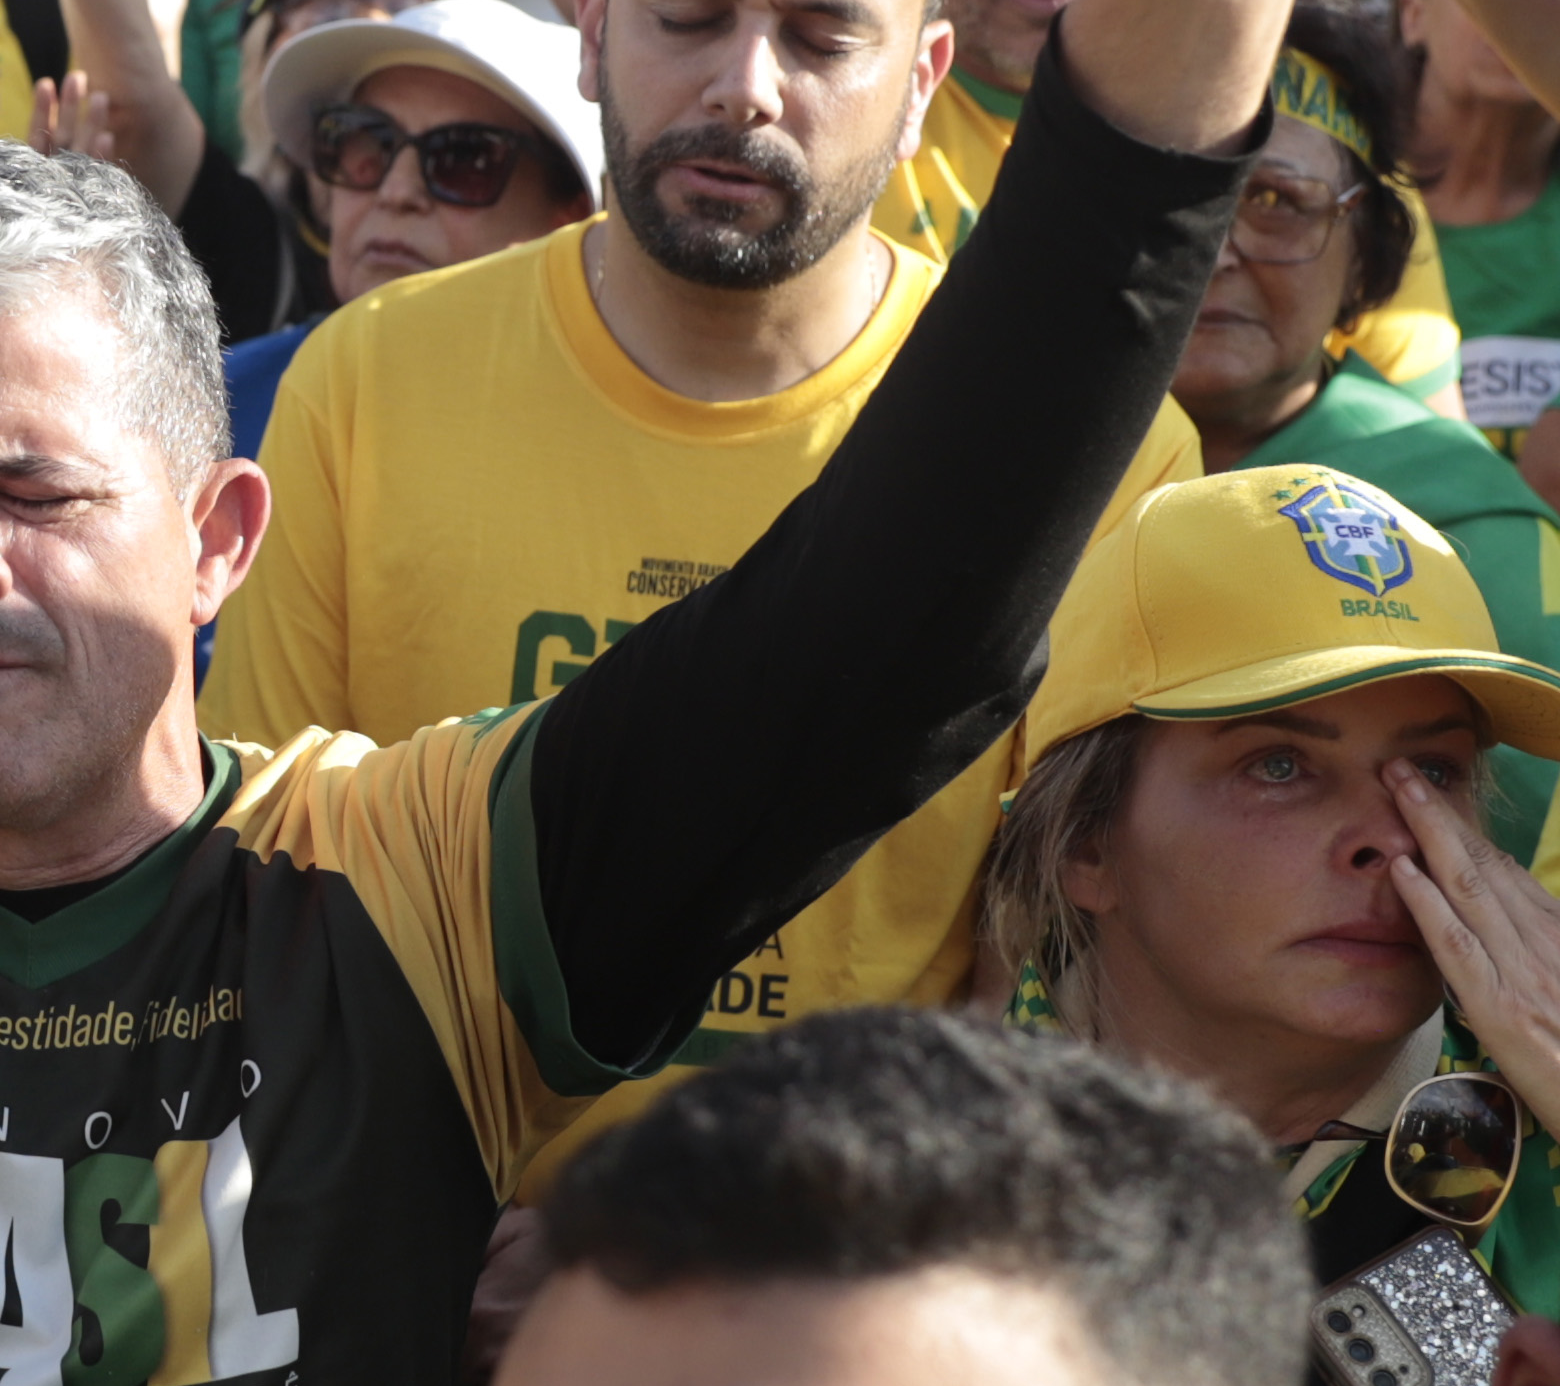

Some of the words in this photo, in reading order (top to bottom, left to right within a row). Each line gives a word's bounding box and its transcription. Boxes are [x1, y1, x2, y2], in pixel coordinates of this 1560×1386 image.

[1334, 524, 1375, 539] CBF
[626, 570, 708, 599] CONSERV
[1339, 598, 1420, 622] BRASIL
[705, 970, 790, 1019] DE
